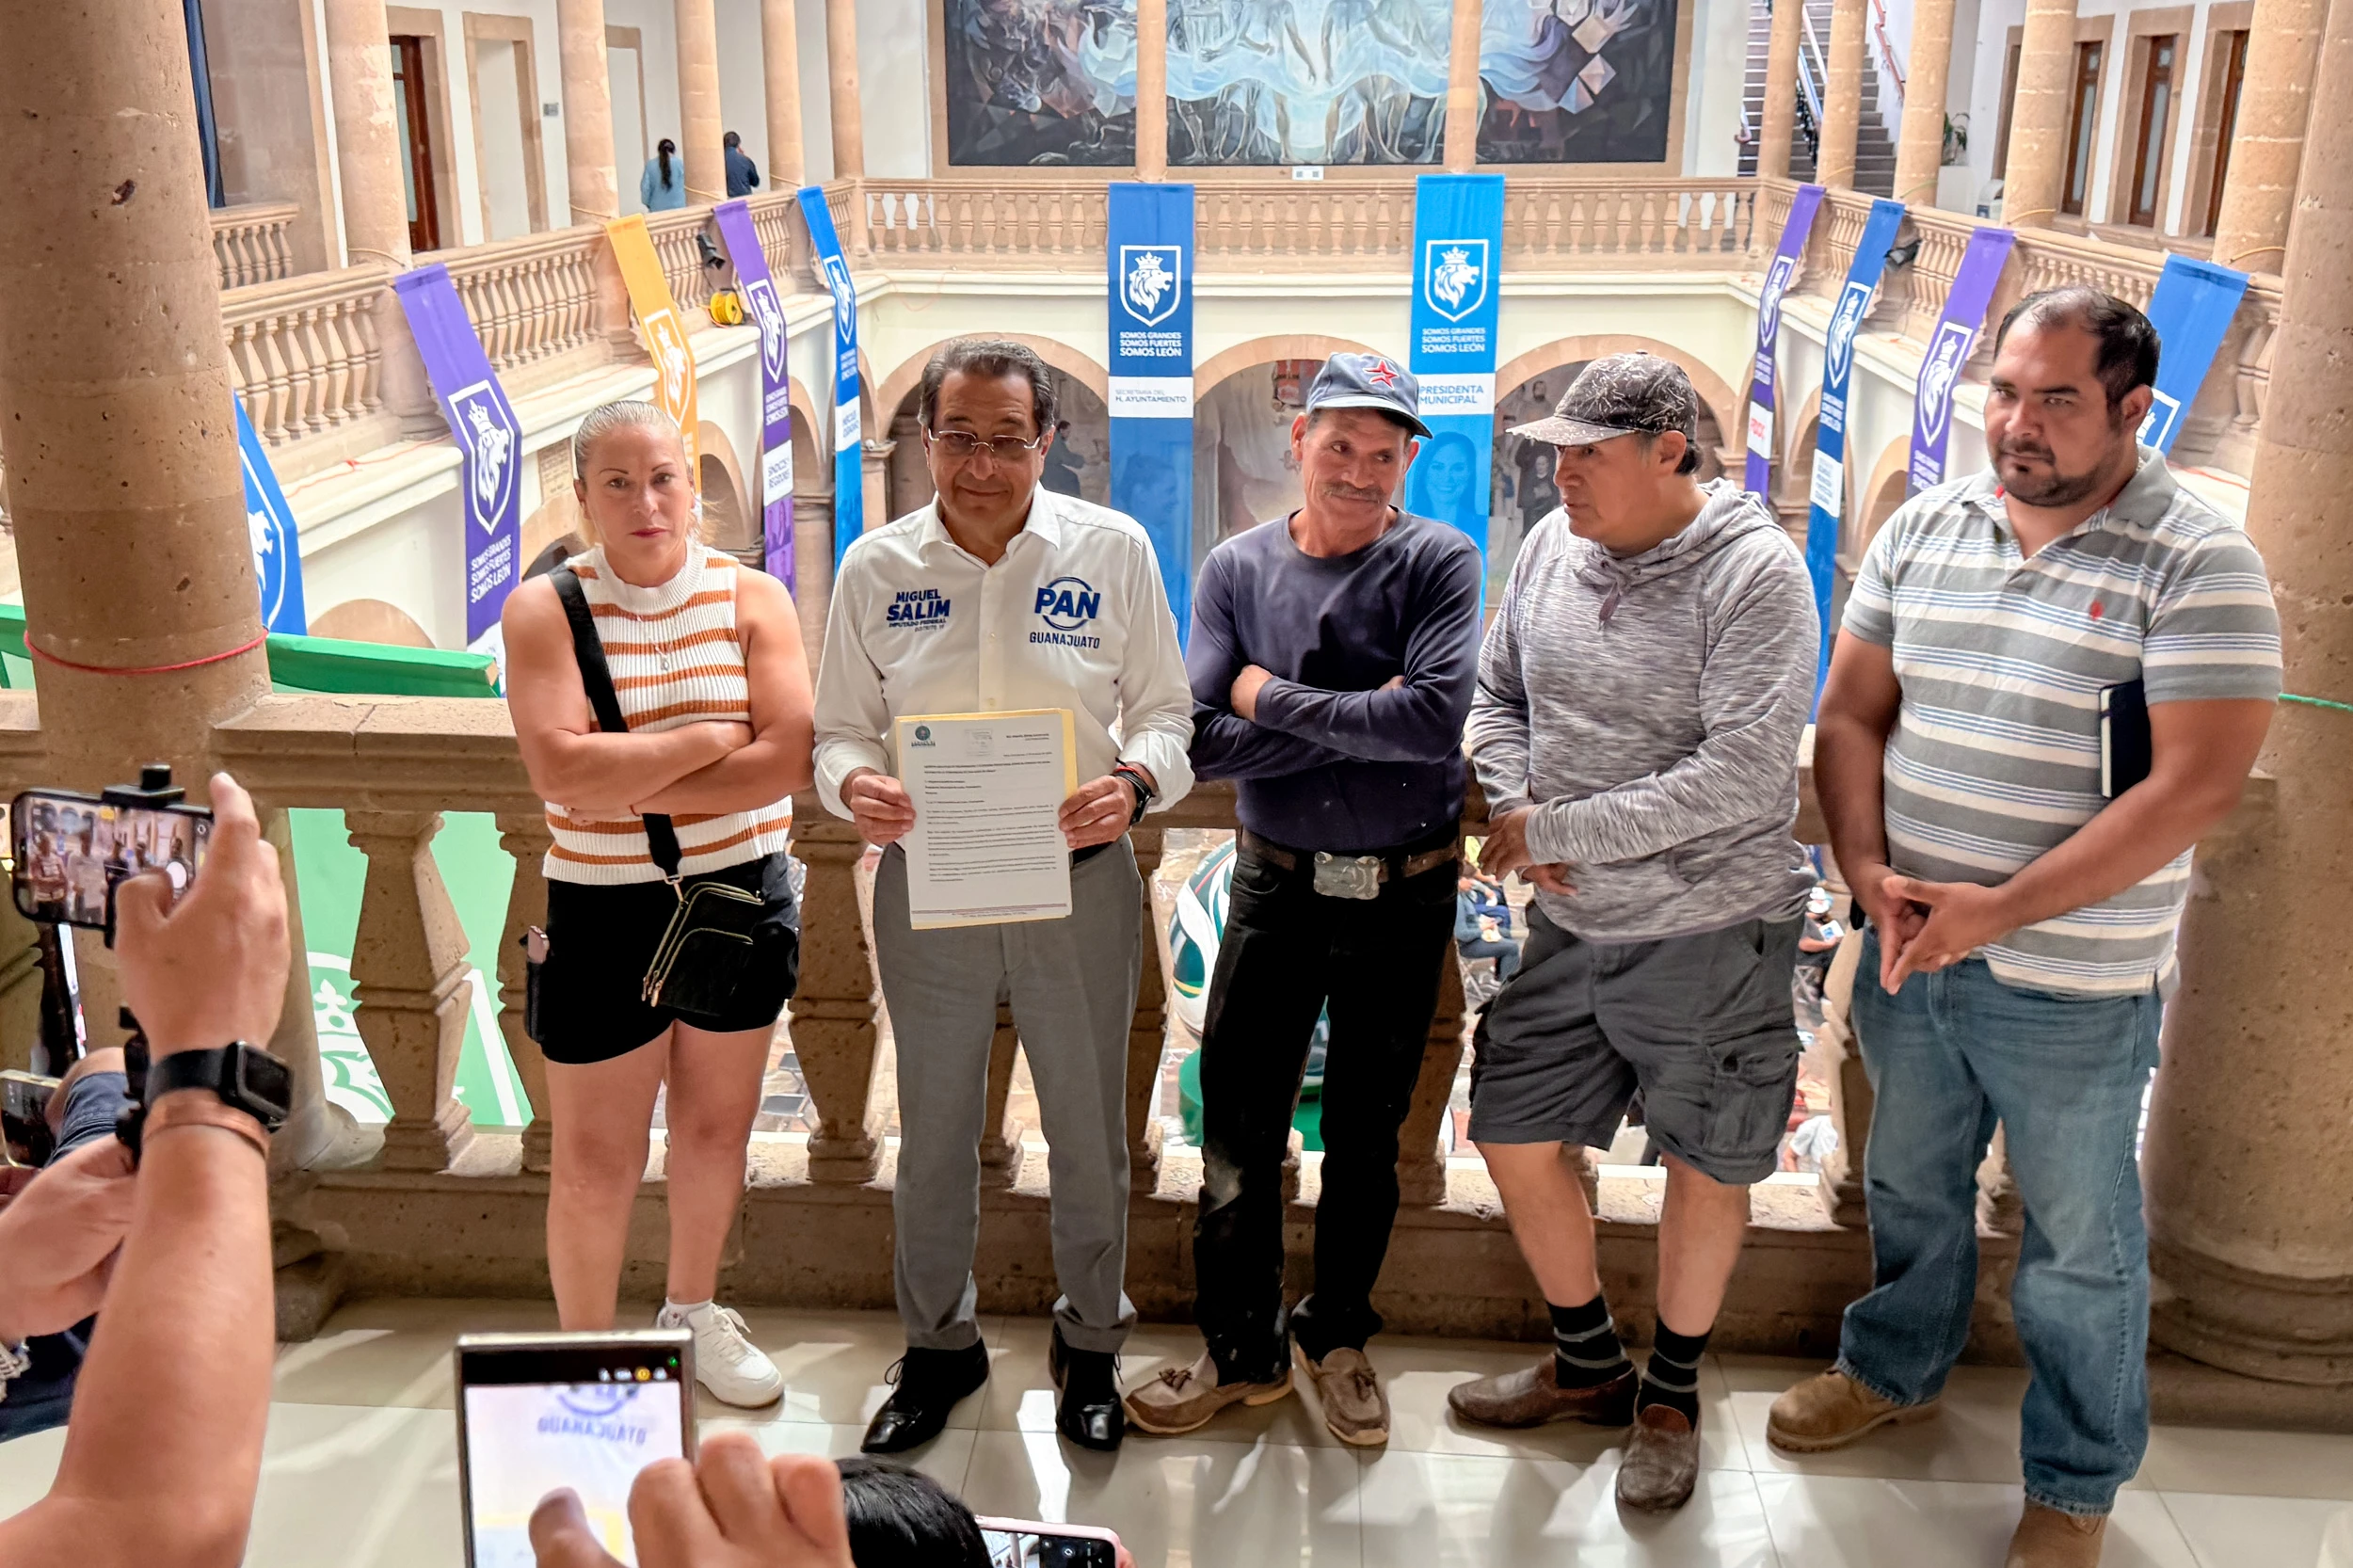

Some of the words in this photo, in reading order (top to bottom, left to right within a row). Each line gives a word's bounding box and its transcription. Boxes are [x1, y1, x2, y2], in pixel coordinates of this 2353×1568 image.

[1119, 347, 1155, 356] SOMOS
[1156, 346, 1182, 356] LEÓN
[1421, 344, 1457, 353] SOMOS
[1459, 342, 1485, 352] LEÓN
[1418, 385, 1484, 394] PRESIDENTA
[1418, 395, 1478, 405] MUNICIPAL
[896, 588, 941, 602] MIGUEL
[1034, 587, 1100, 618] PAN
[887, 599, 951, 621] SALIM
[1030, 632, 1100, 648] GUANAJUATO
[537, 1416, 648, 1446] GUANAJUATO
